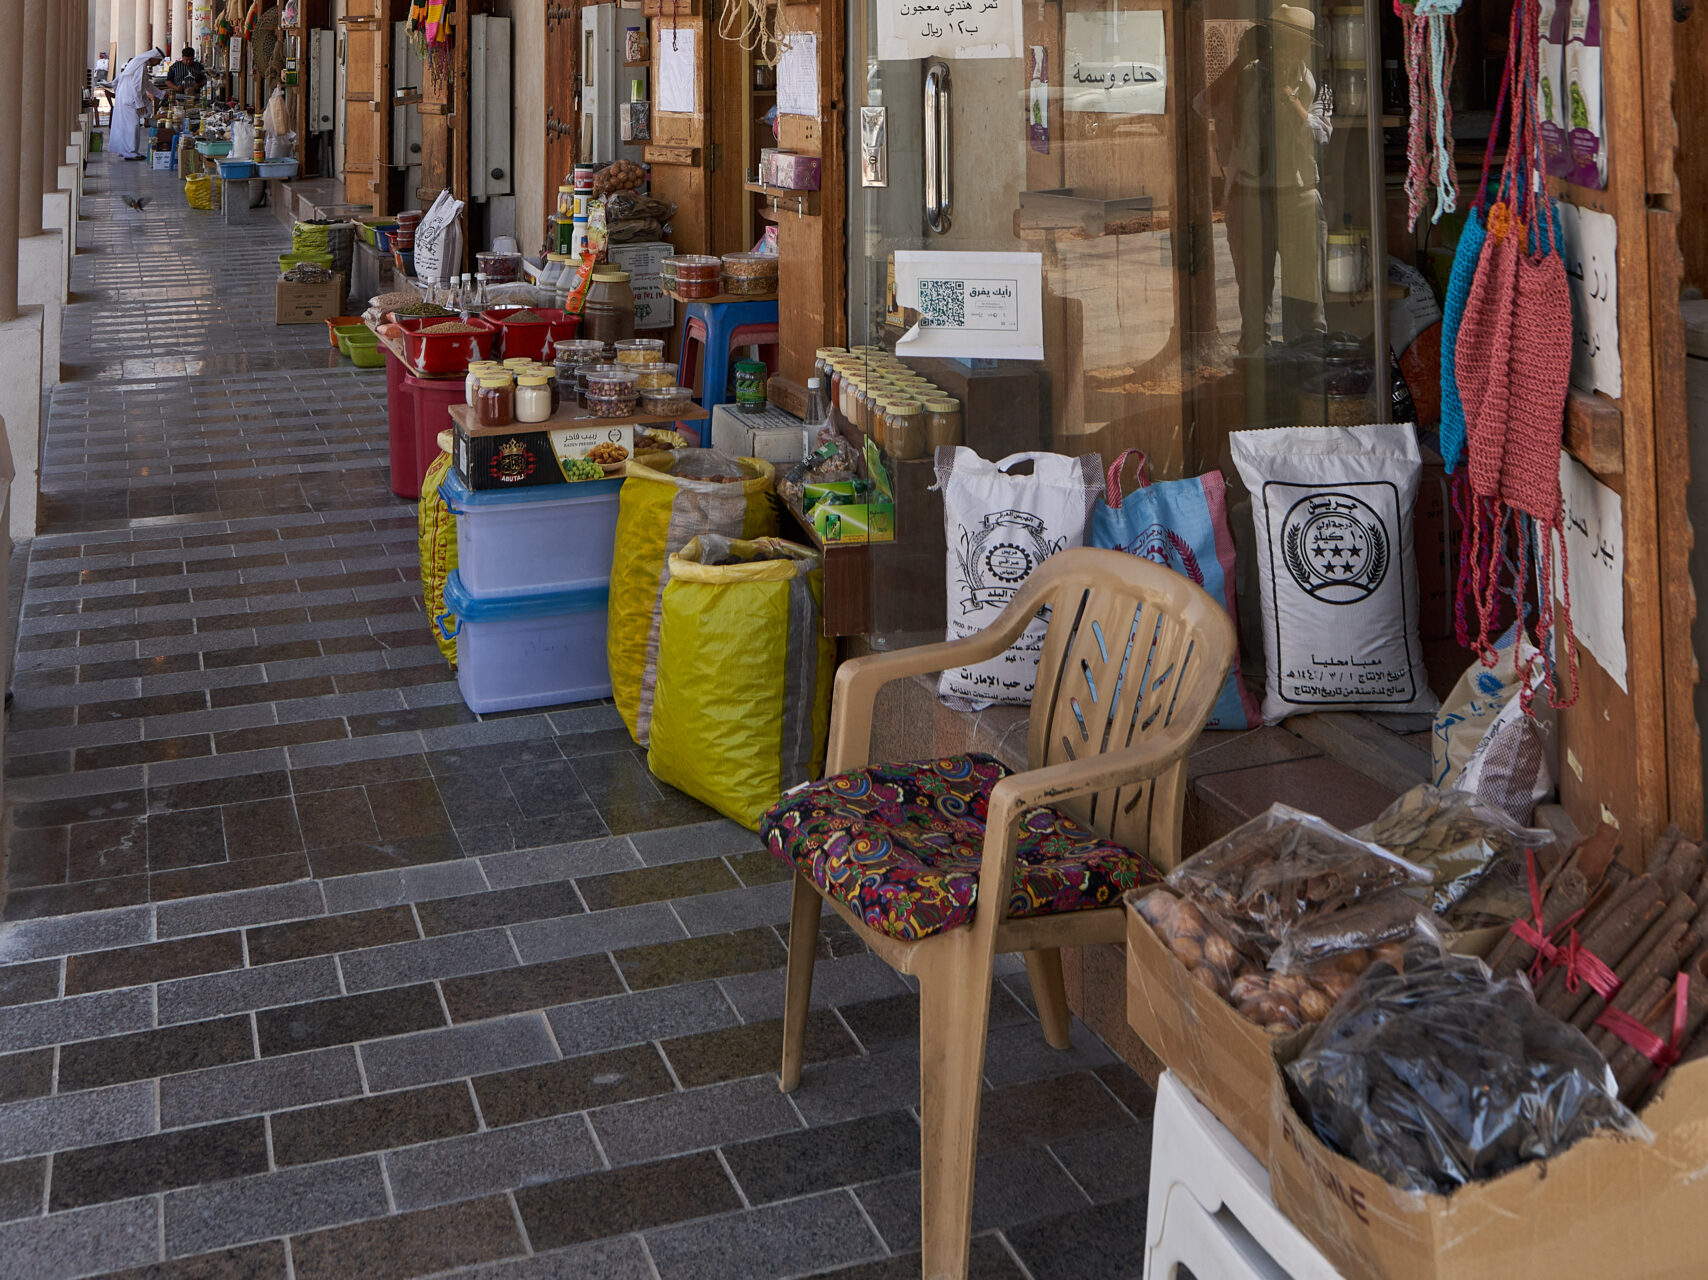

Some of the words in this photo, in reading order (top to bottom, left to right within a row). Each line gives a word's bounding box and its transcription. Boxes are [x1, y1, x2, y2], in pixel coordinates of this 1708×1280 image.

[900, 3, 941, 17] معجون
[943, 0, 973, 17] هندي
[921, 21, 943, 38] ريال
[1072, 61, 1116, 91] وسمة
[1122, 61, 1158, 85] حناء
[969, 286, 991, 299] يفرق
[992, 284, 1013, 299] رأيك
[501, 473, 525, 482] ABUTAJ
[1307, 498, 1359, 515] جريش
[1312, 531, 1344, 545] كيلو
[960, 667, 1000, 688] الإمارات
[1358, 671, 1385, 683] الإنتاج
[1002, 679, 1020, 690] حب
[1293, 685, 1320, 696] الإنتاج
[1354, 686, 1371, 695] سنة
[1371, 686, 1385, 695] لمدة
[1320, 686, 1342, 697] تاريخ
[1342, 687, 1354, 698] من
[1386, 686, 1406, 697] صالح
